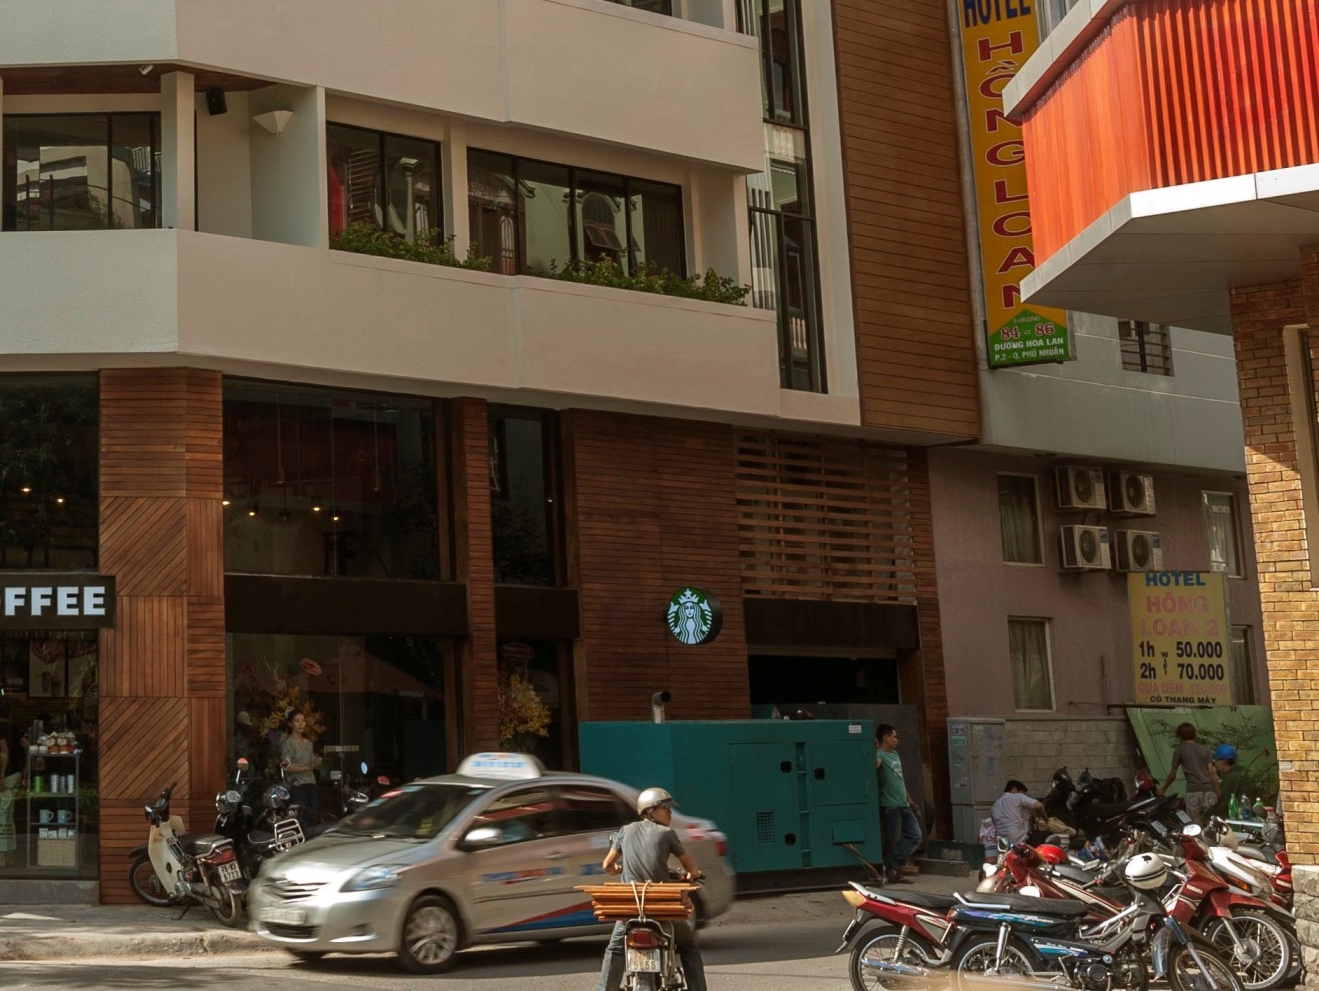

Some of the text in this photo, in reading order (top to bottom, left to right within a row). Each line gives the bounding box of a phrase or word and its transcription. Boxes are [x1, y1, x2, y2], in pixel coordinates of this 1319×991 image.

[1001, 327, 1020, 340] 84
[1035, 322, 1055, 336] 86
[1026, 339, 1043, 348] HOA
[1046, 337, 1064, 346] LAN
[1145, 571, 1206, 586] HOTEL
[1140, 618, 1220, 637] LOAN 2
[1139, 640, 1223, 658] 1h 50.000
[1140, 663, 1224, 681] 2h 70.000
